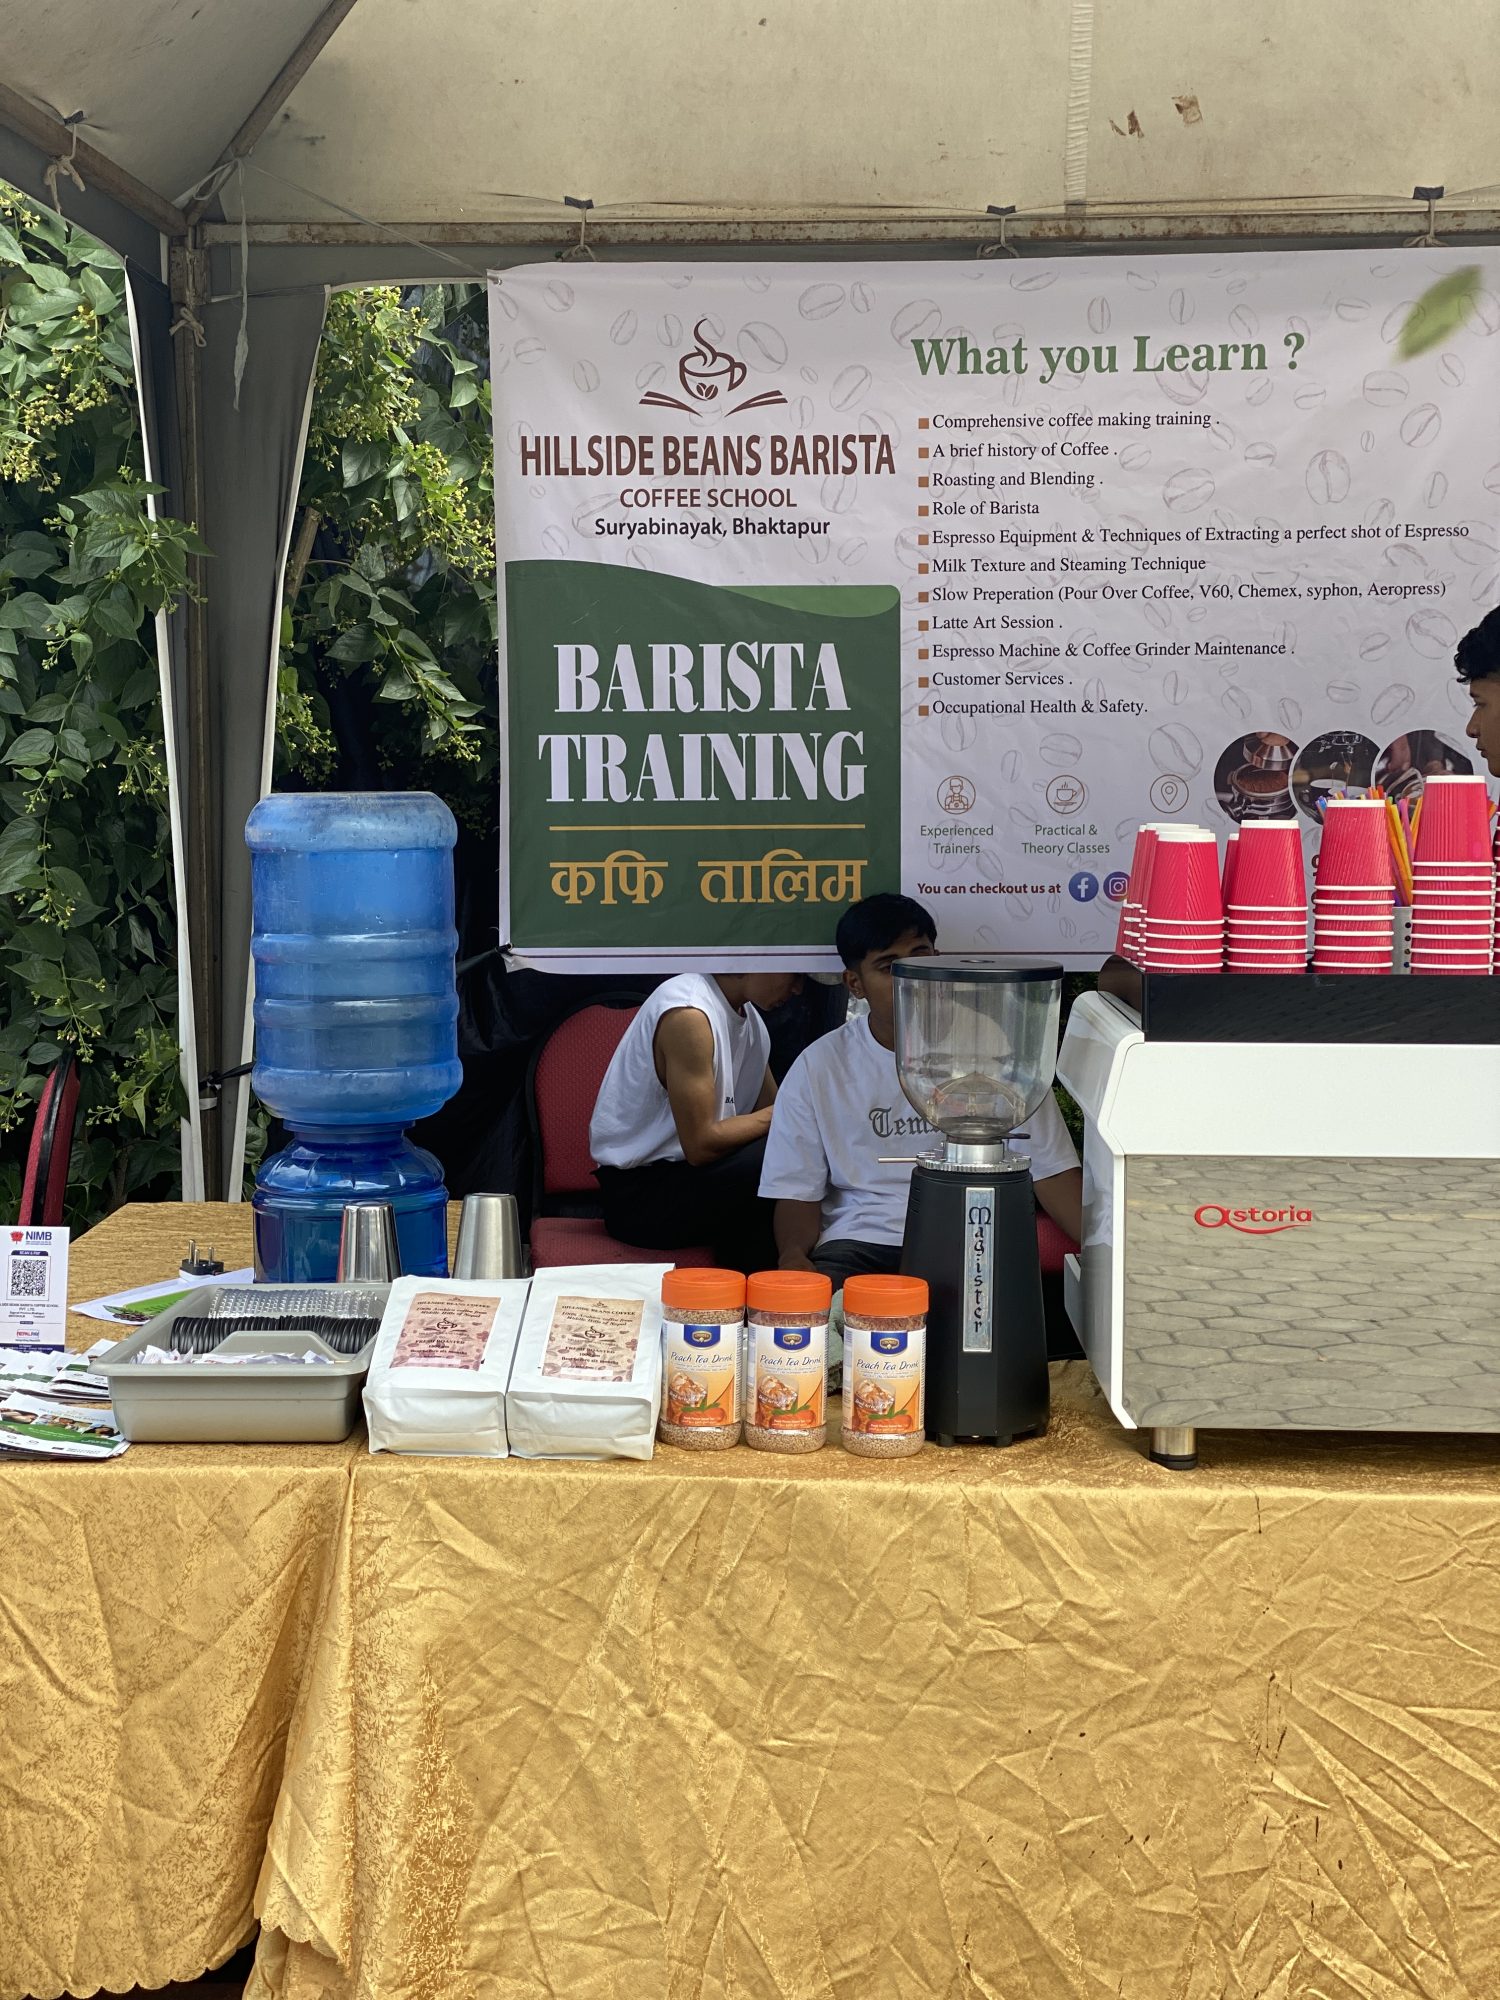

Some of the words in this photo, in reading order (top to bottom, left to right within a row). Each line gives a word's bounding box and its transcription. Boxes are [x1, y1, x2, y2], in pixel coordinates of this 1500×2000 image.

[911, 337, 1028, 375] What
[1039, 345, 1118, 384] you
[1133, 335, 1268, 372] Learn
[933, 414, 1044, 431] Comprehensive
[1049, 413, 1093, 426] coffee
[1098, 412, 1151, 429] making
[1156, 411, 1211, 428] training
[521, 436, 653, 476] HILLSIDE
[663, 435, 761, 476] BEANS
[772, 434, 895, 475] BARISTA
[933, 444, 945, 457] A
[950, 443, 984, 457] brief
[988, 443, 1037, 460] history
[1042, 442, 1057, 456] of
[1061, 442, 1108, 456] Coffee
[933, 473, 995, 489] Roasting
[1000, 472, 1025, 485] and
[1030, 471, 1094, 488] Blending
[620, 489, 700, 508] COFFEE
[708, 488, 797, 508] SCHOOL
[933, 502, 965, 515] Role
[970, 501, 986, 514] of
[990, 501, 1039, 514] Barista
[595, 518, 727, 540] Suryabinayak,
[733, 518, 830, 539] Bhaktapur
[933, 531, 995, 547] Espresso
[1000, 530, 1077, 547] Equipment
[1082, 529, 1094, 542] &
[1100, 528, 1181, 545] Techniques
[1186, 528, 1202, 541] of
[1205, 526, 1279, 543] Extracting
[1284, 530, 1292, 539] a
[1296, 525, 1346, 543] perfect
[1351, 525, 1381, 538] shot
[1386, 524, 1401, 537] of
[1405, 524, 1469, 541] Espresso
[933, 559, 966, 572] Milk
[971, 559, 1025, 572] Texture
[1031, 558, 1055, 571] and
[1060, 557, 1126, 574] Steaming
[1131, 557, 1206, 573] Technique
[933, 588, 968, 600] Slow
[974, 587, 1053, 604] Preperation
[1059, 587, 1098, 602] (Pour
[1102, 586, 1137, 599] Over
[1142, 585, 1193, 600] Coffee,
[1199, 585, 1233, 599] V60,
[1238, 584, 1301, 599] Chemex,
[1307, 583, 1362, 600] syphon,
[1368, 581, 1445, 599] Aeropress)
[933, 616, 968, 629] Latte
[973, 616, 996, 628] Art
[1001, 615, 1053, 628] Session
[933, 645, 994, 661] Espresso
[999, 644, 1060, 656] Machine
[1065, 643, 1078, 656] &
[1083, 643, 1131, 656] Coffee
[1136, 642, 1190, 656] Grinder
[1195, 642, 1286, 655] Maintenance
[554, 641, 851, 713] BARISTA
[933, 672, 1001, 685] Customer
[1005, 672, 1063, 685] Services
[933, 700, 1025, 717] Occupational
[1031, 700, 1076, 713] Health
[1082, 700, 1094, 712] &
[1100, 699, 1147, 716] Safety.
[538, 731, 867, 803] TRAINING
[921, 825, 993, 839] Experienced
[1035, 825, 1085, 836] Practical
[1088, 825, 1097, 835] &
[934, 843, 980, 854] Trainers
[1022, 843, 1063, 856] Theory
[1067, 843, 1110, 854] Classes
[698, 848, 867, 903] तालिम
[918, 883, 941, 895] You
[946, 885, 965, 894] can
[970, 883, 1027, 894] checkout
[1032, 885, 1045, 893] us
[1048, 884, 1061, 893] at
[869, 1107, 940, 1138] Tem
[26, 1231, 52, 1241] NIMB
[671, 1352, 691, 1361] Peach
[695, 1355, 708, 1363] Tea
[760, 1355, 782, 1365] Peach
[786, 1358, 799, 1366] Tea
[857, 1359, 879, 1370] Peach
[883, 1362, 896, 1370] Tea
